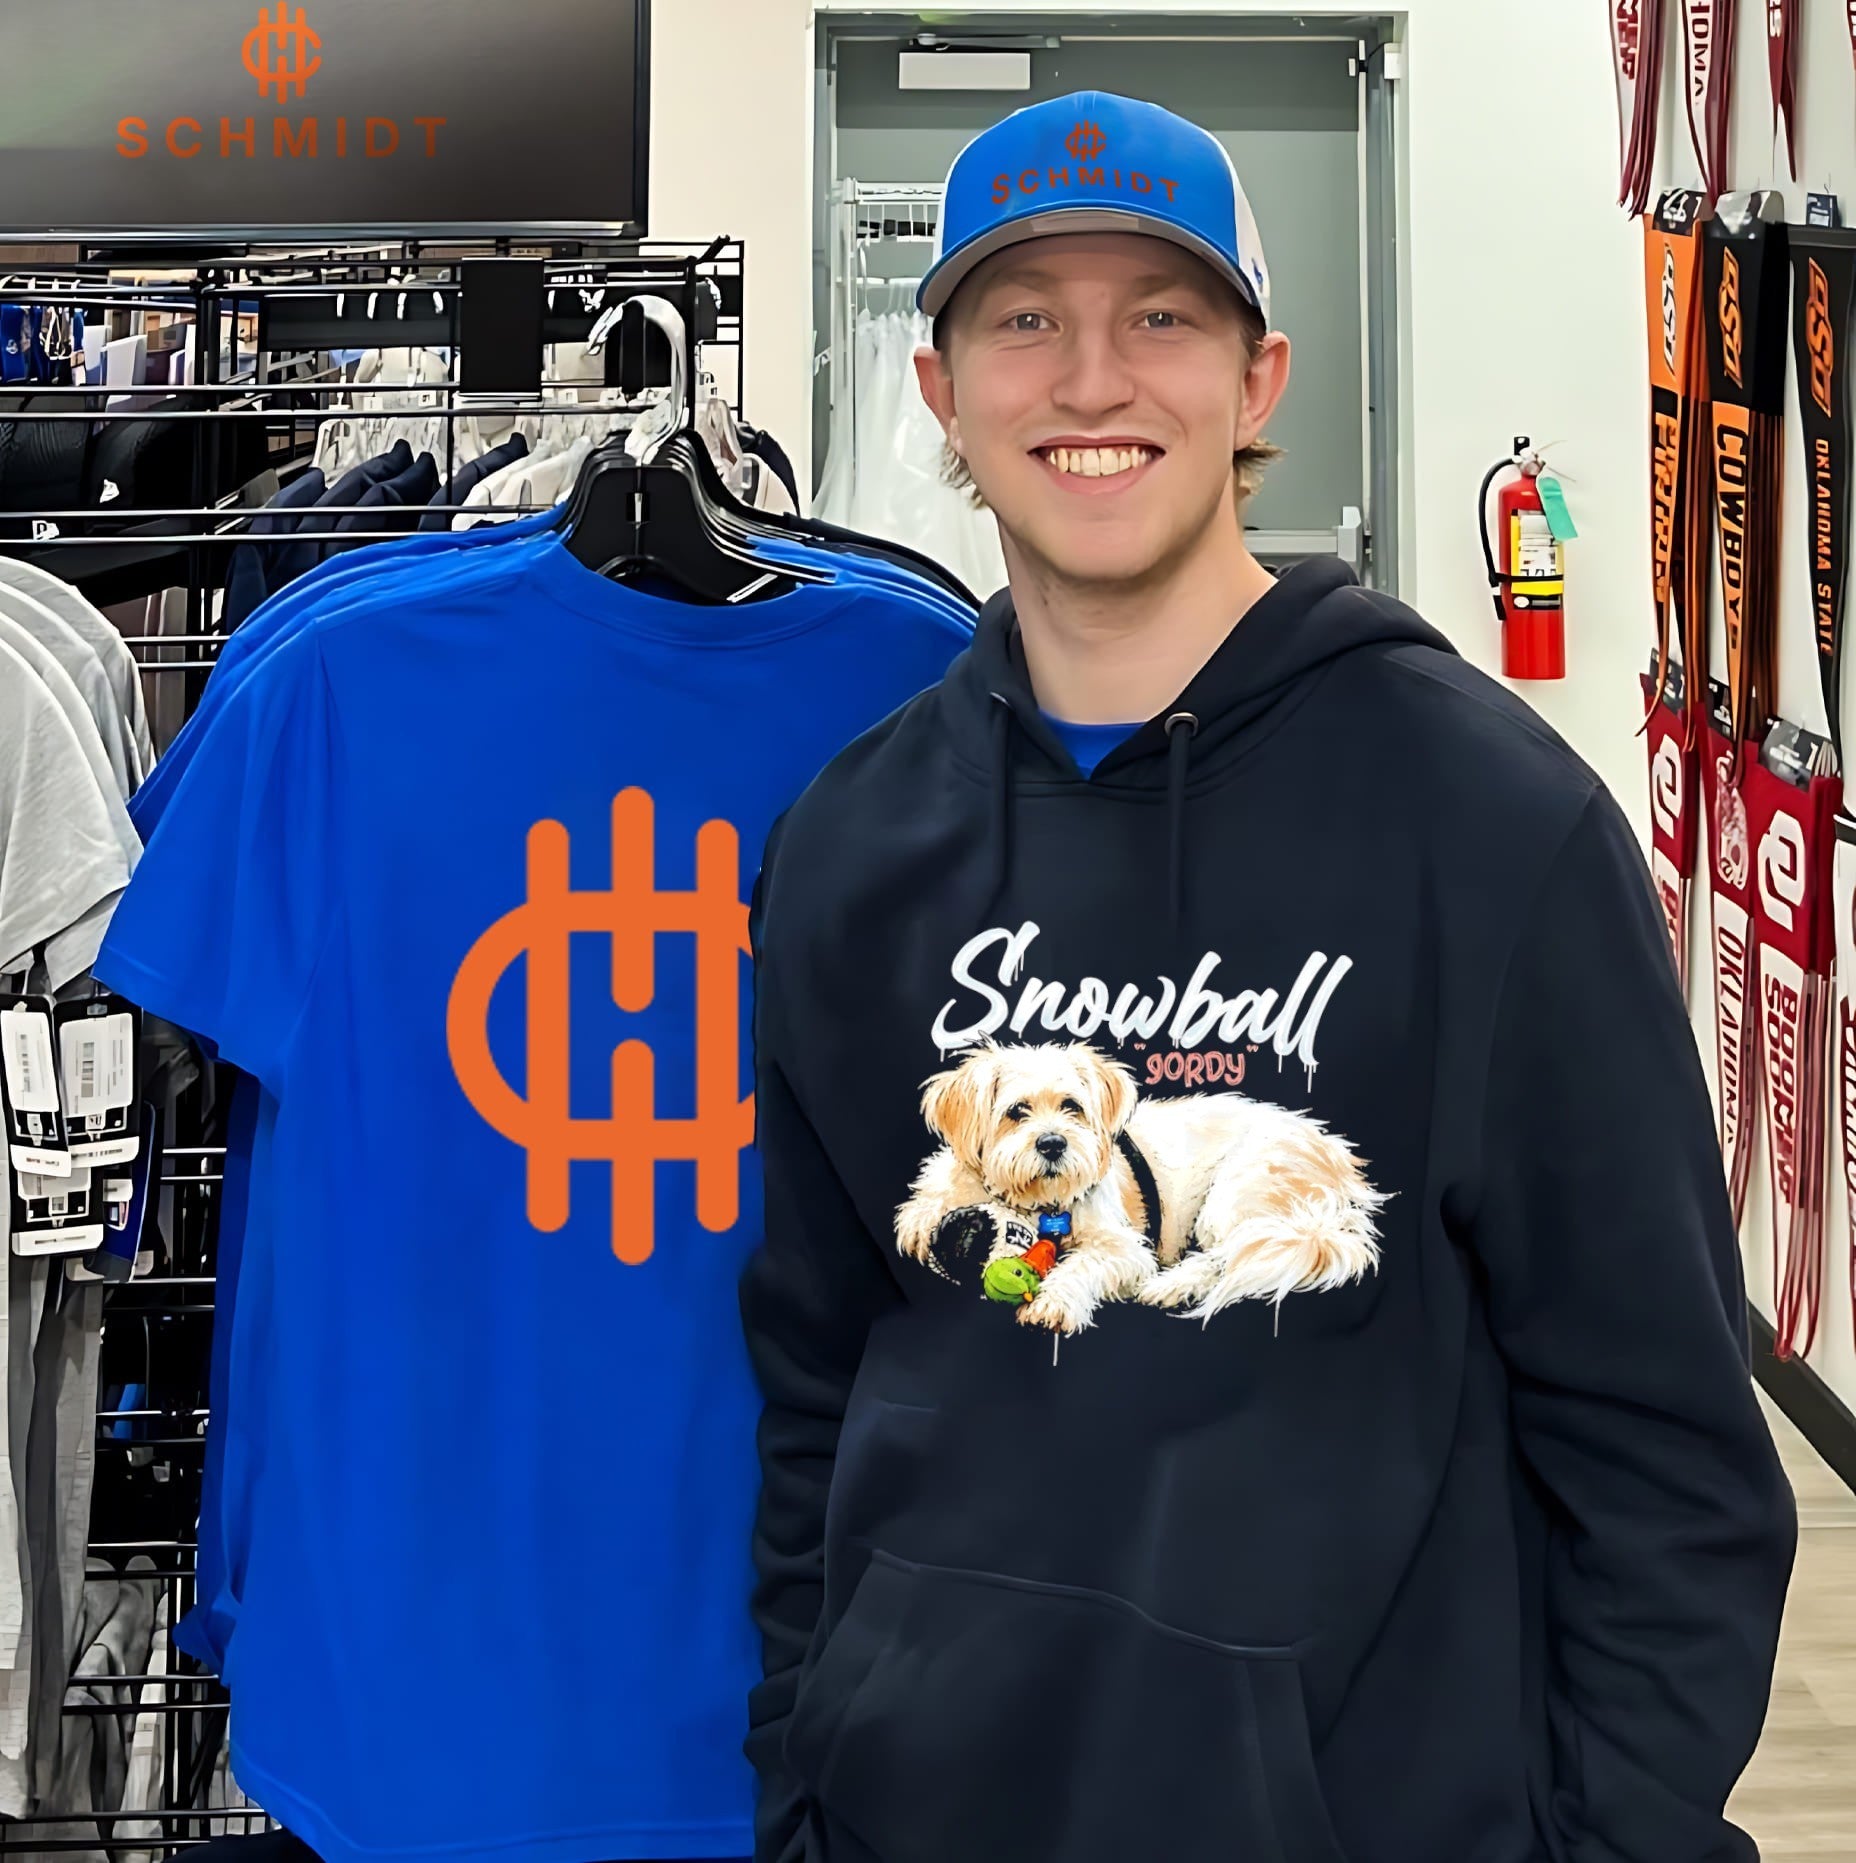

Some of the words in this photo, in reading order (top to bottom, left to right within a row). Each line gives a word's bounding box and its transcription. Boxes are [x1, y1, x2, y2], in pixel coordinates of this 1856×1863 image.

[116, 116, 448, 159] SCHMIDT
[991, 166, 1180, 205] SCHMIDT
[930, 919, 1354, 1076] Snowball
[1718, 925, 1746, 1145] OKLAHOMA
